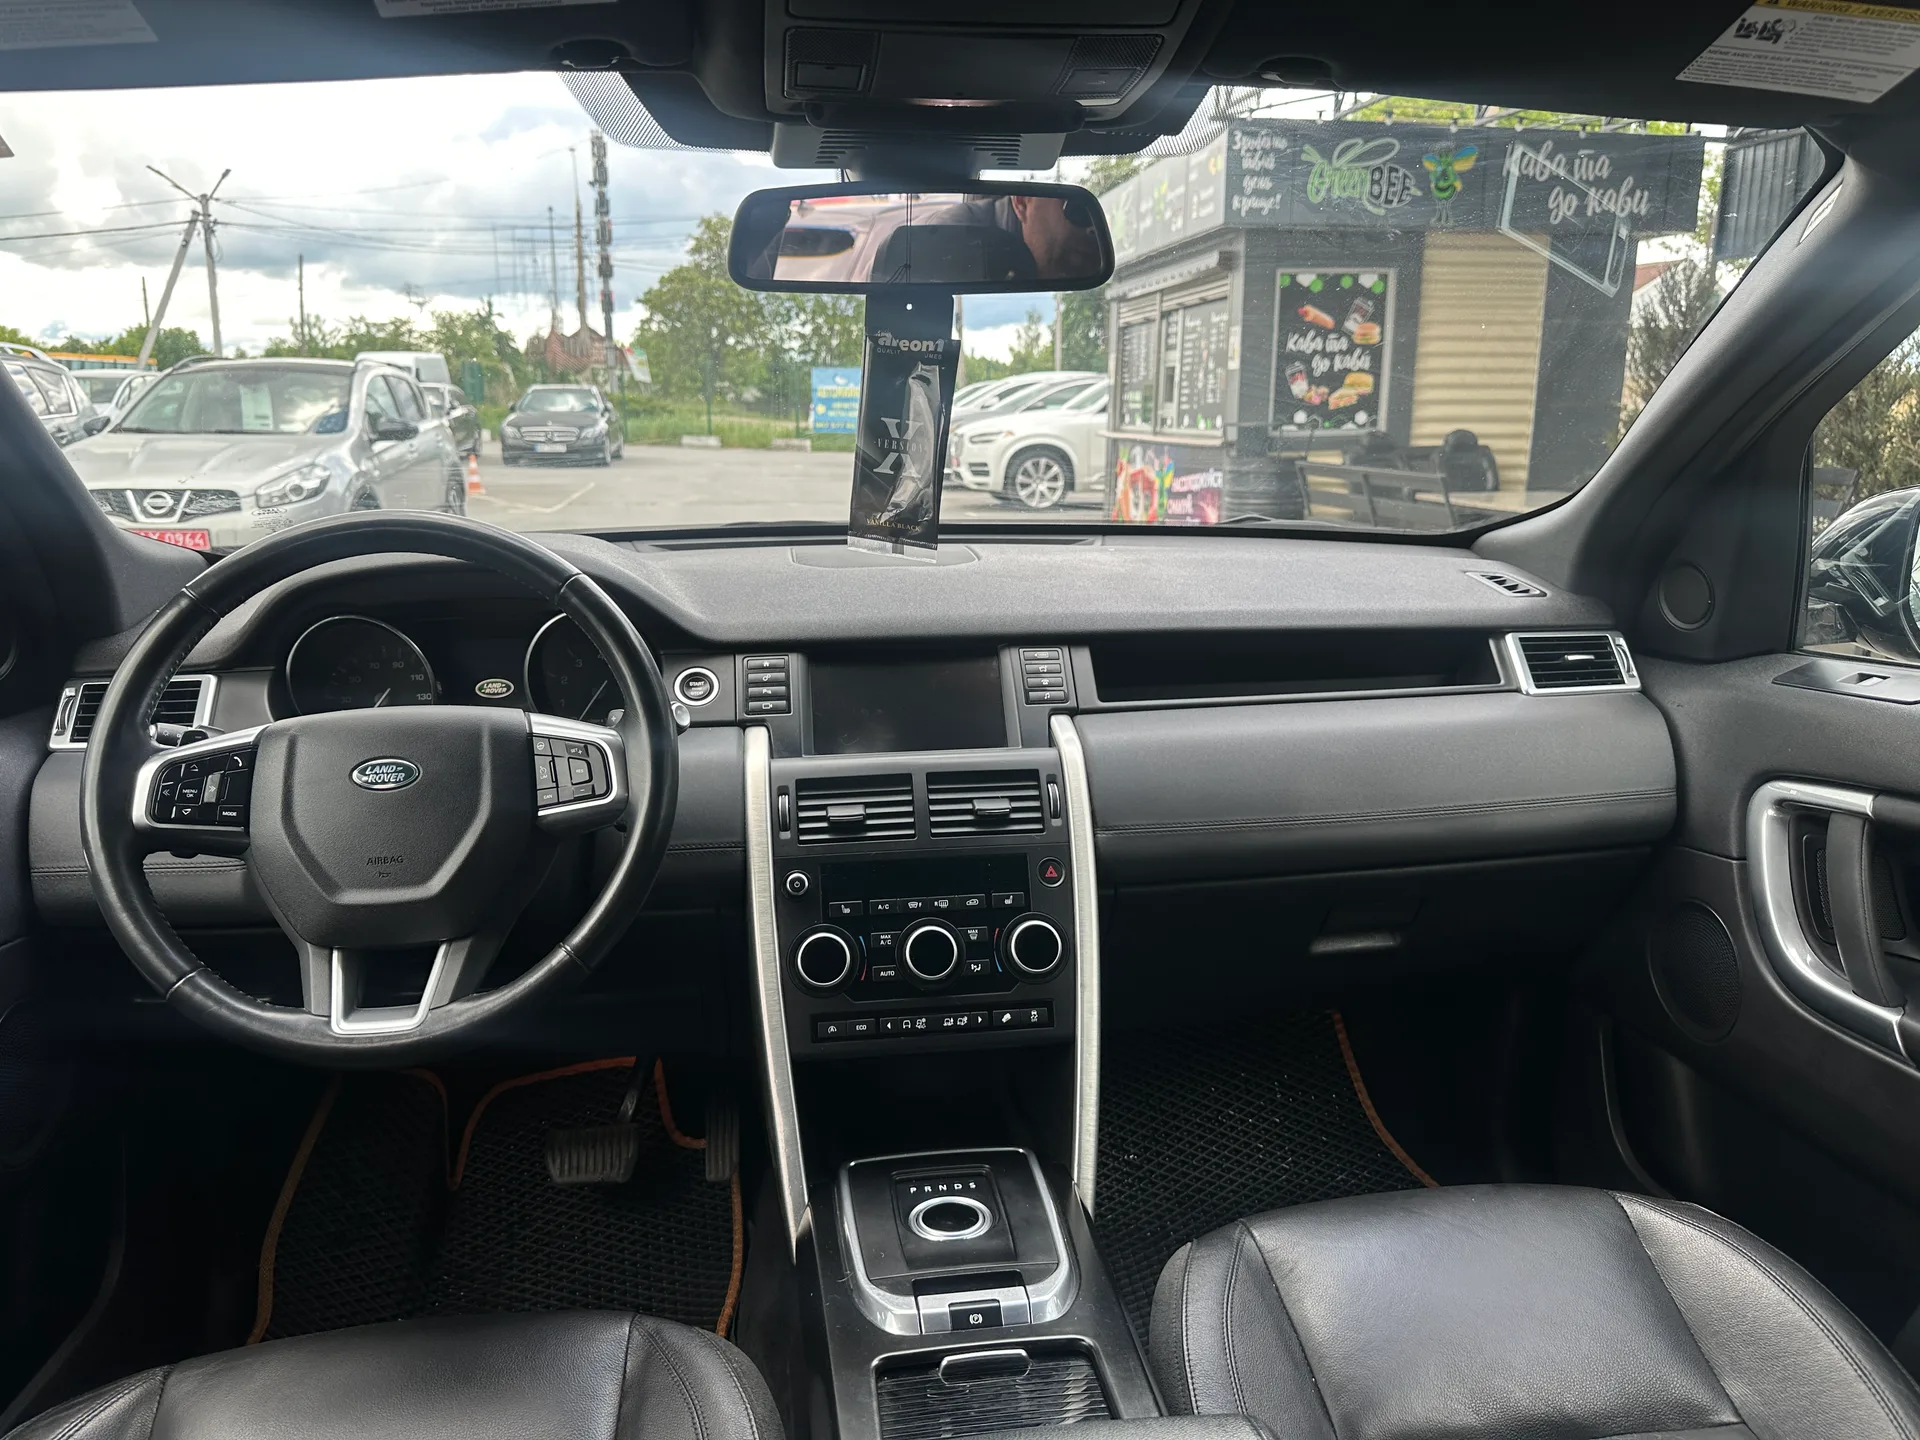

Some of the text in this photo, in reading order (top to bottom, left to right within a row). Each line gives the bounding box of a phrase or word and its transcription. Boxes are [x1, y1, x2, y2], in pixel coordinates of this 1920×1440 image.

[1547, 175, 1651, 225] до кави
[1286, 329, 1323, 354] Кава
[897, 523, 921, 532] BLACK
[164, 532, 205, 547] 0964
[365, 764, 396, 775] LAND
[367, 772, 406, 783] ROVER
[366, 855, 404, 866] AIRBAG
[910, 1186, 917, 1194] P
[924, 1185, 932, 1193] R
[938, 1184, 947, 1192] N
